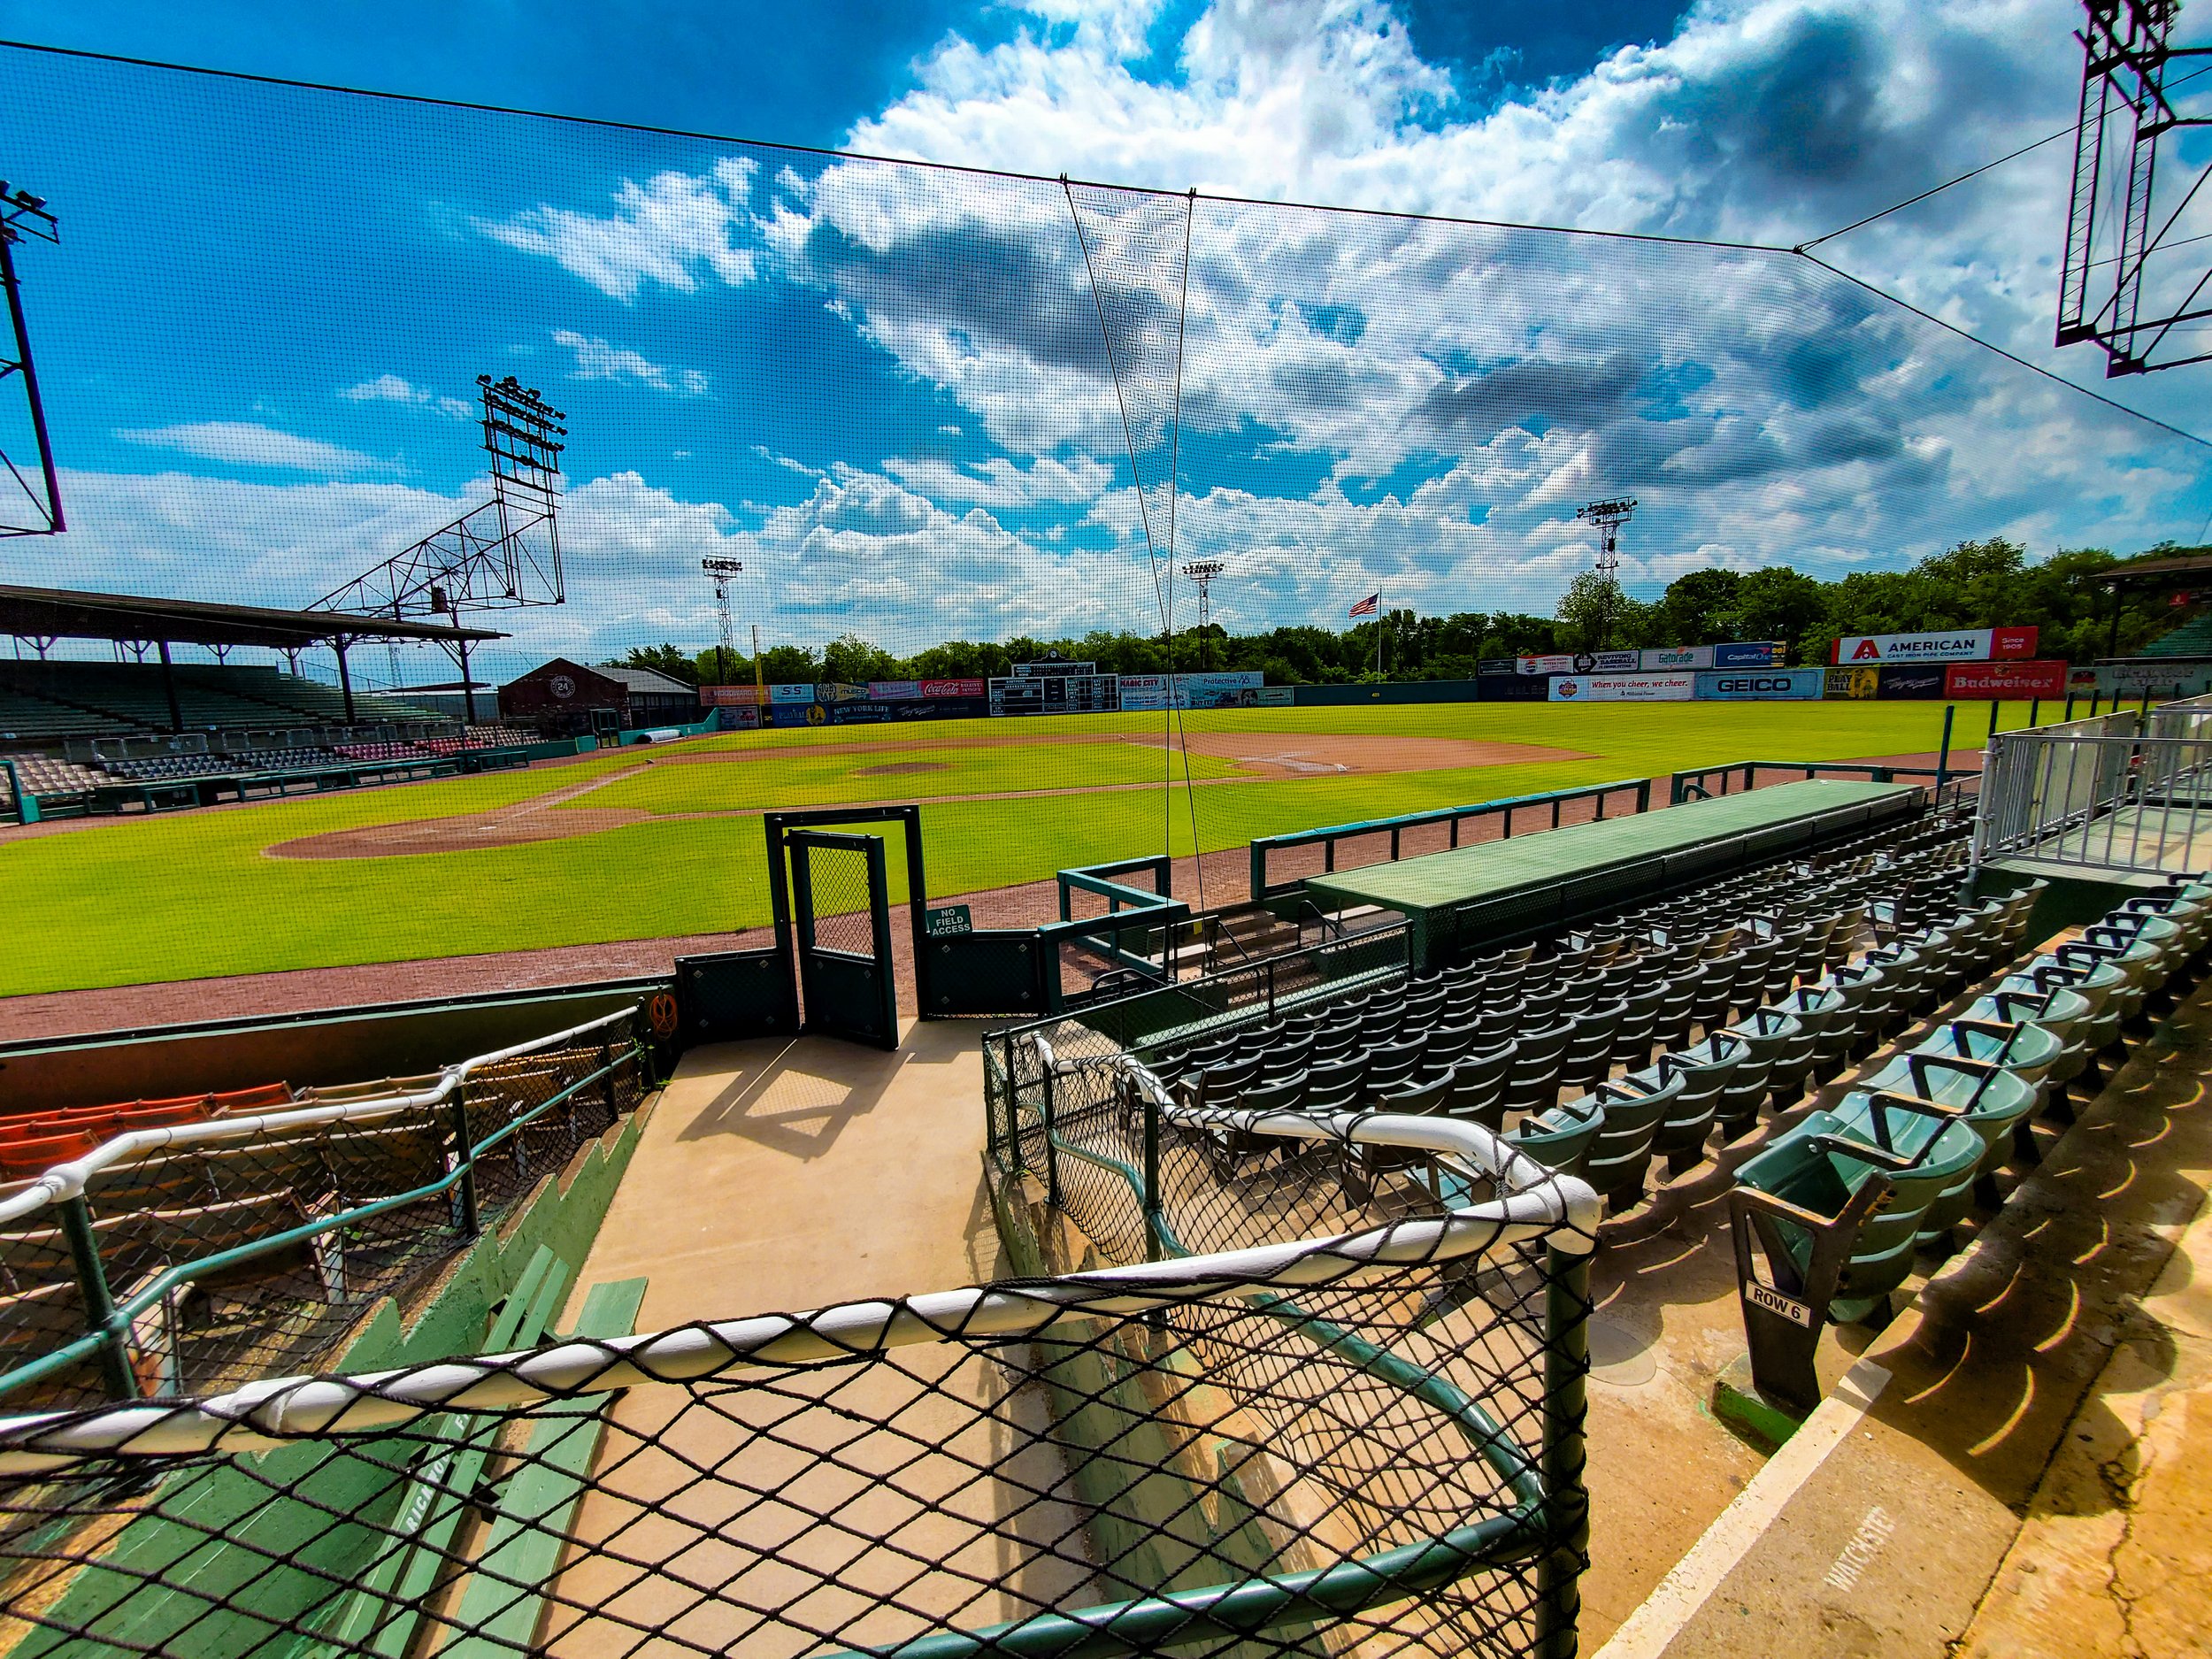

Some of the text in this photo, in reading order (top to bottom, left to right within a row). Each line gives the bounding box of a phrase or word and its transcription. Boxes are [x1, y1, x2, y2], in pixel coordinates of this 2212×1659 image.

[1887, 639, 1976, 654] AMERICAN
[1658, 652, 1694, 664] Gatorade
[1726, 652, 1756, 662] Capital
[1120, 679, 1142, 687] MAGIC
[1203, 677, 1237, 686] Protective
[1827, 674, 1853, 683] PLAY
[1952, 675, 2055, 691] Budweiser
[557, 682, 569, 691] 24
[1592, 680, 1612, 689] When
[1613, 681, 1626, 690] you
[1627, 680, 1650, 689] cheer,
[1664, 679, 1688, 688] cheer.
[1717, 678, 1792, 695] GEICO
[1826, 682, 1851, 692] BALL
[833, 707, 851, 716] NEW
[852, 704, 873, 713] YORK
[941, 908, 956, 918] NO
[935, 916, 964, 927] FIELD
[932, 923, 972, 936] ACCESS
[1754, 1287, 1801, 1319] ROW 6
[405, 1445, 455, 1534] RICKWOO
[1823, 1536, 1878, 1594] WATCH
